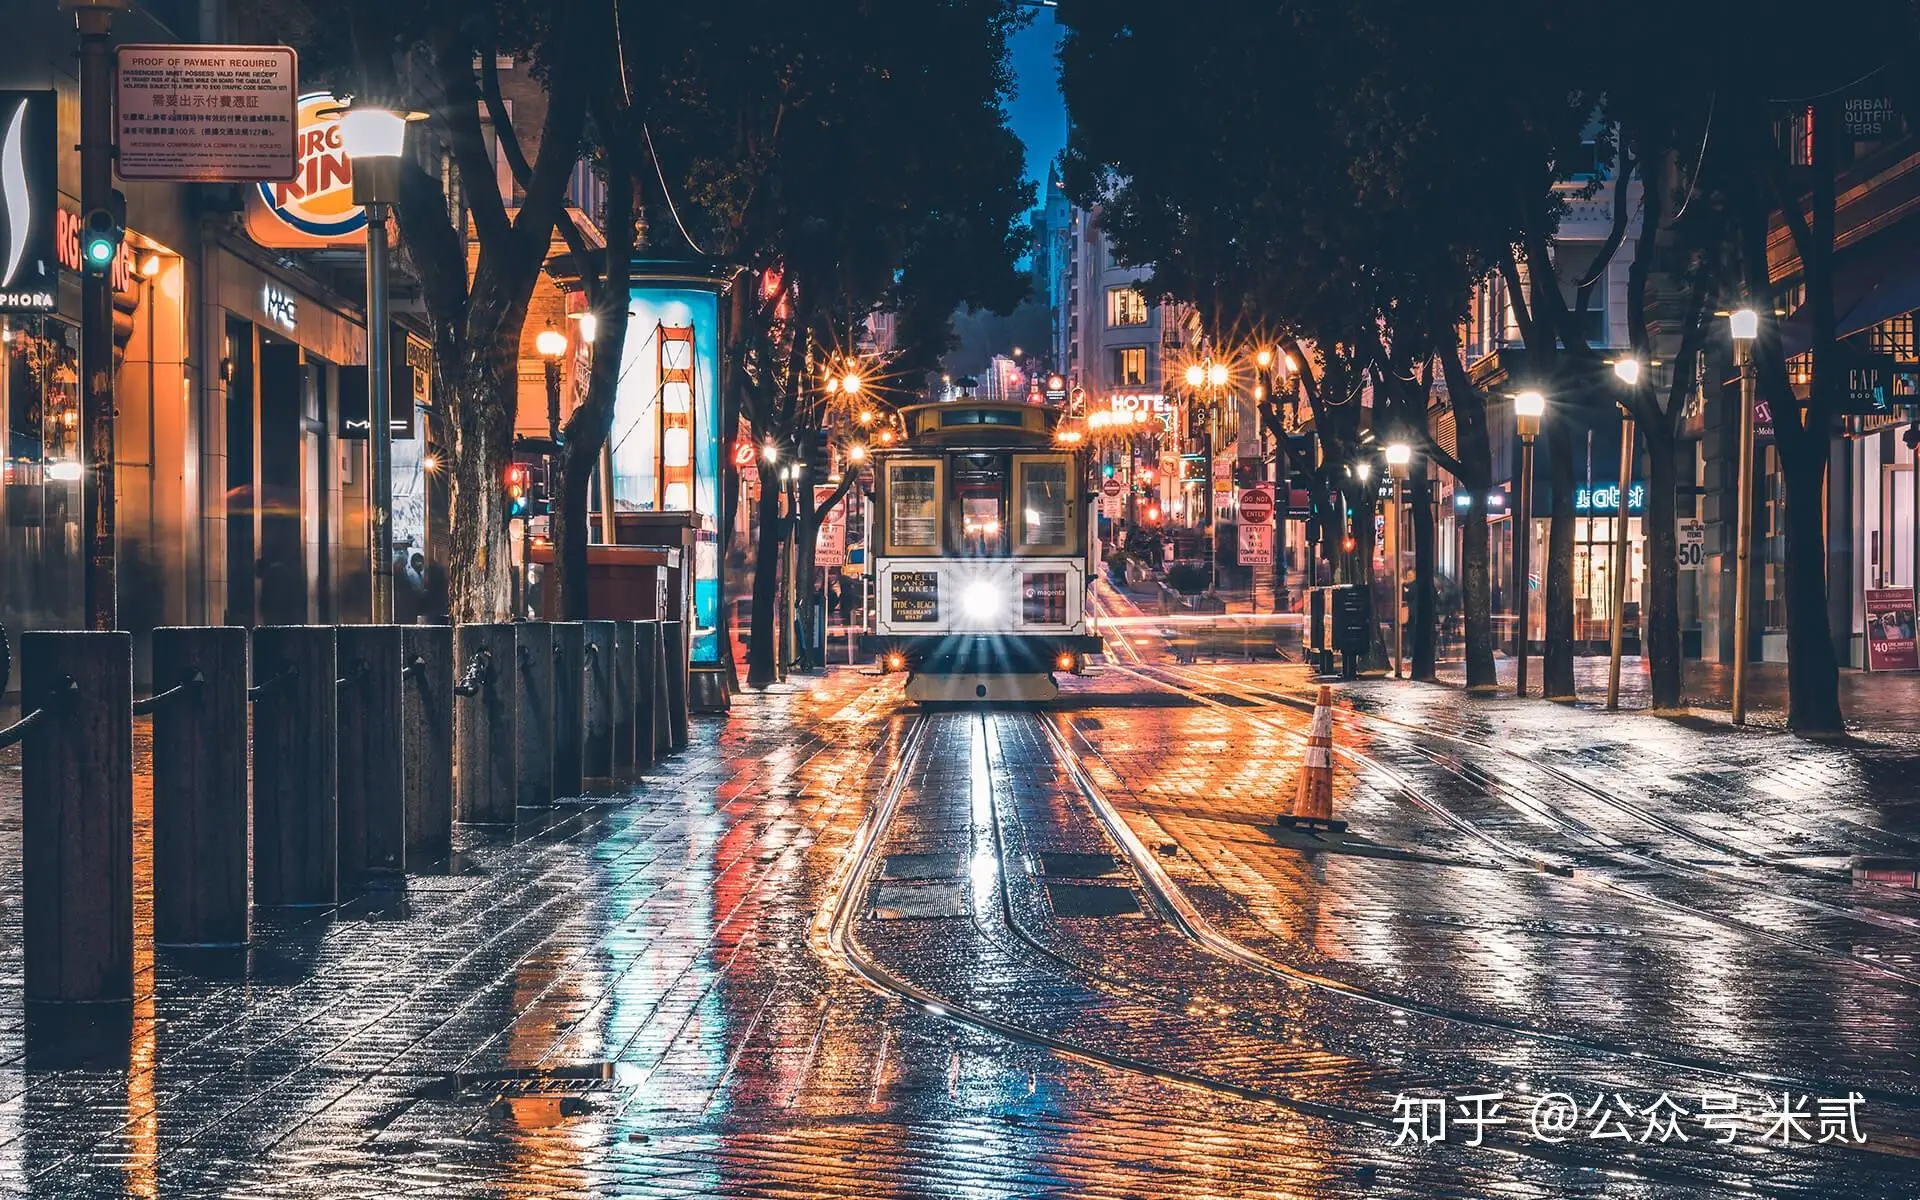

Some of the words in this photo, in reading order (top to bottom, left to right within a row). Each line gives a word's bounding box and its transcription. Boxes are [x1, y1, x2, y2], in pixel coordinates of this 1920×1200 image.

[132, 58, 164, 66] PROOF
[230, 59, 277, 67] REQUIRED
[1845, 98, 1892, 110] URBAN
[1845, 123, 1881, 135] TERS
[265, 284, 298, 328] MAC
[1850, 369, 1878, 390] GAP
[346, 420, 407, 429] MC
[893, 601, 908, 609] HYDE
[916, 601, 936, 609] BEACH
